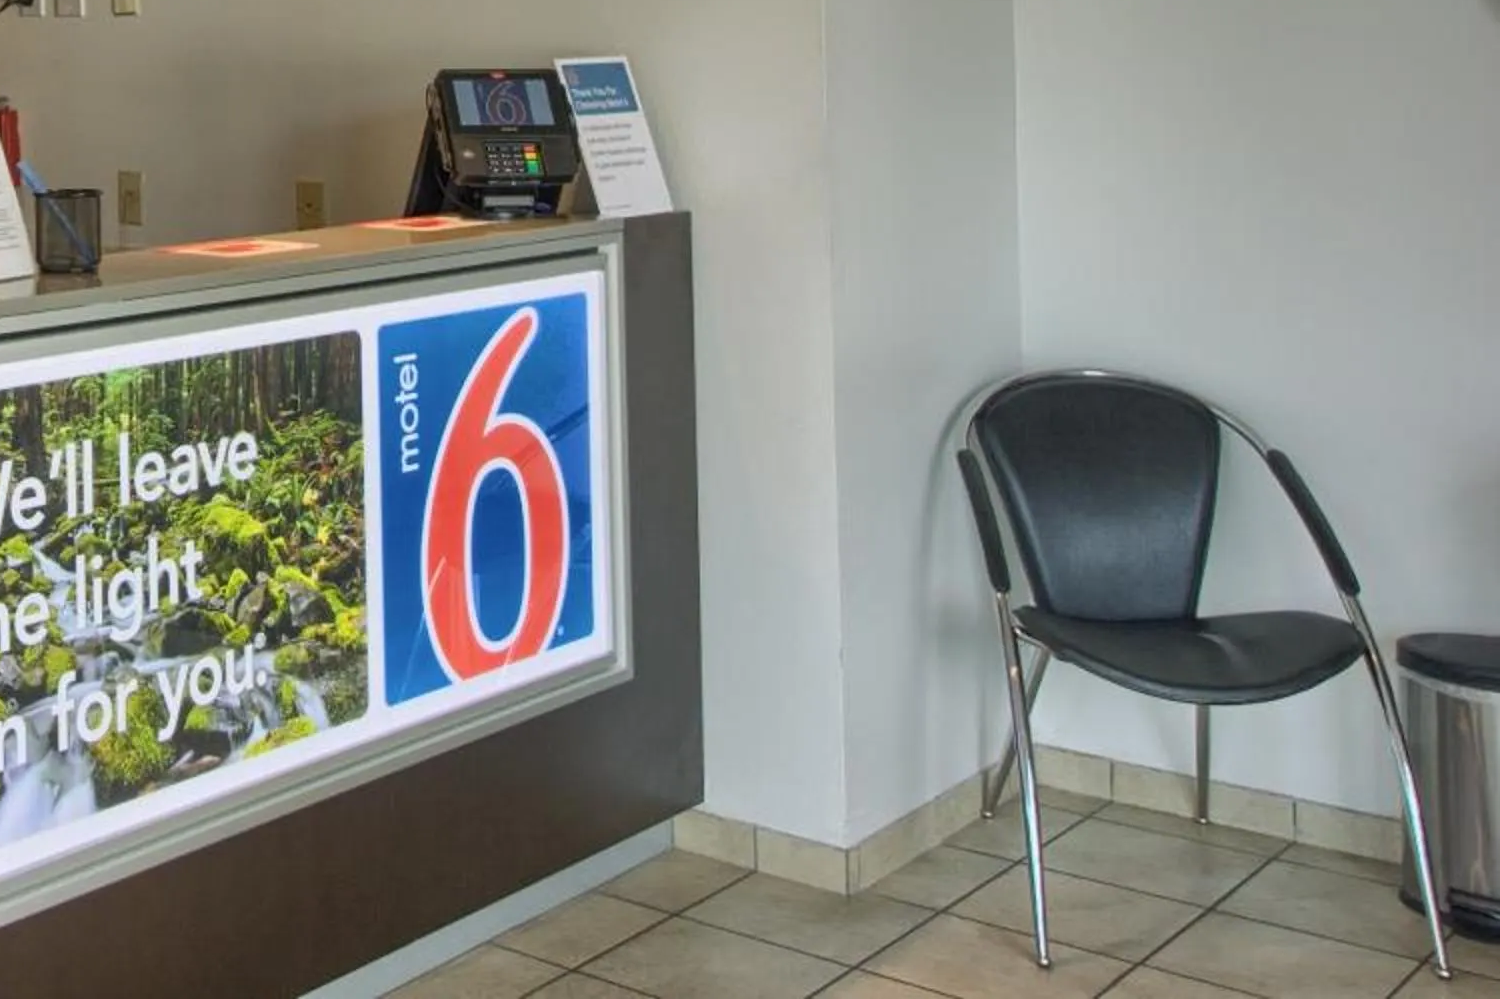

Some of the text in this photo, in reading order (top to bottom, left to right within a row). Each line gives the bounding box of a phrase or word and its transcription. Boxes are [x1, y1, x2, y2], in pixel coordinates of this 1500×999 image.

[394, 353, 420, 473] motel
[119, 431, 258, 507] leave
[420, 306, 570, 685] 6
[75, 536, 204, 641] light
[51, 670, 138, 752] for
[157, 643, 268, 742] you.
